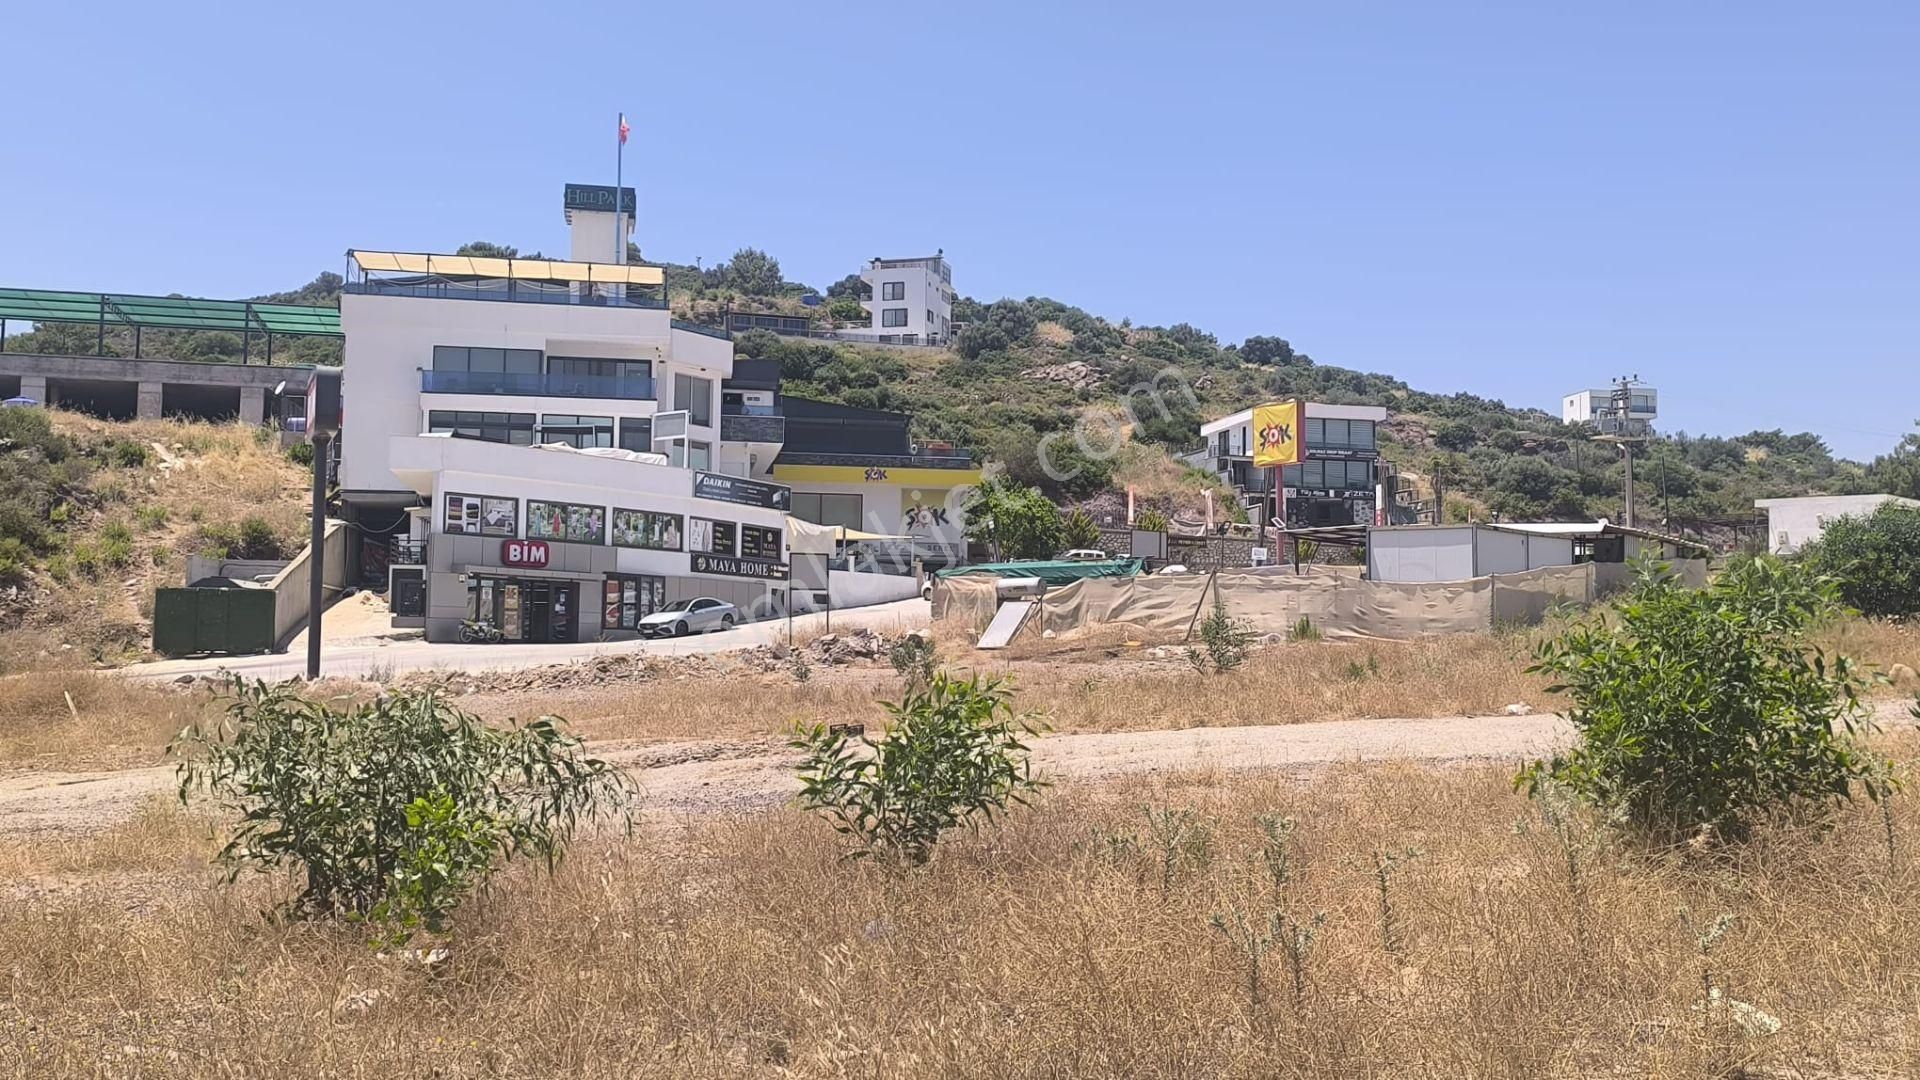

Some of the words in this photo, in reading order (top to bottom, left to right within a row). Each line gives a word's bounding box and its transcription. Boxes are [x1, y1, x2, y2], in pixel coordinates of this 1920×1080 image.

[598, 190, 633, 207] PAK
[703, 476, 732, 489] DAIKIN
[509, 541, 546, 563] BİM
[708, 557, 737, 573] MAYA
[740, 561, 769, 576] HOME
